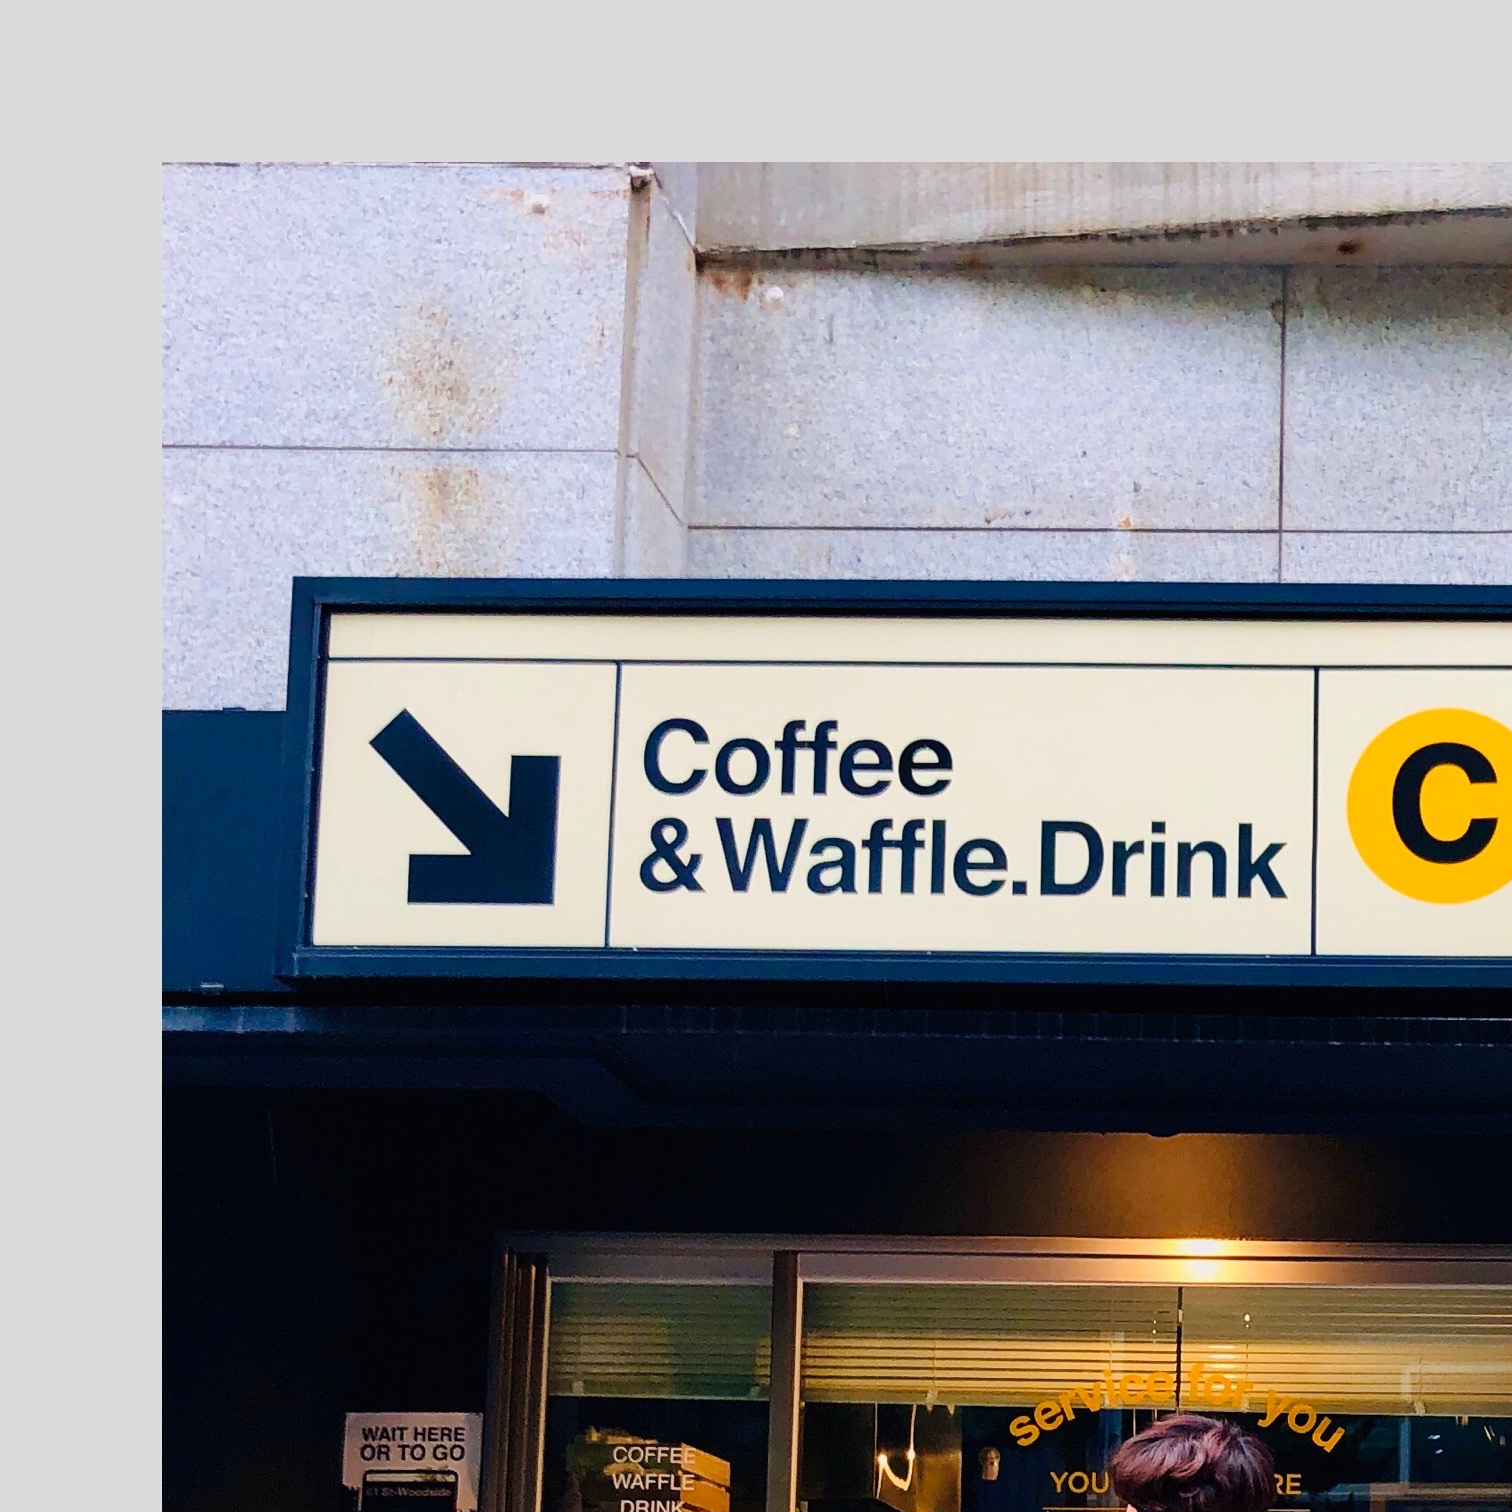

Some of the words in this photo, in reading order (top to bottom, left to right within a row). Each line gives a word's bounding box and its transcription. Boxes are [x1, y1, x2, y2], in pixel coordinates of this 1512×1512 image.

[643, 717, 953, 797] Coffee
[1392, 742, 1498, 864] C
[1009, 1368, 1177, 1447] service
[1187, 1363, 1255, 1410] for
[1257, 1390, 1346, 1453] you
[361, 1426, 409, 1443] WAIT
[413, 1426, 466, 1443] HERE
[360, 1444, 391, 1462] OR
[398, 1444, 427, 1462] TO
[432, 1444, 466, 1462] GO
[612, 1446, 697, 1465] COFFEE
[611, 1473, 696, 1491] WAFFLE
